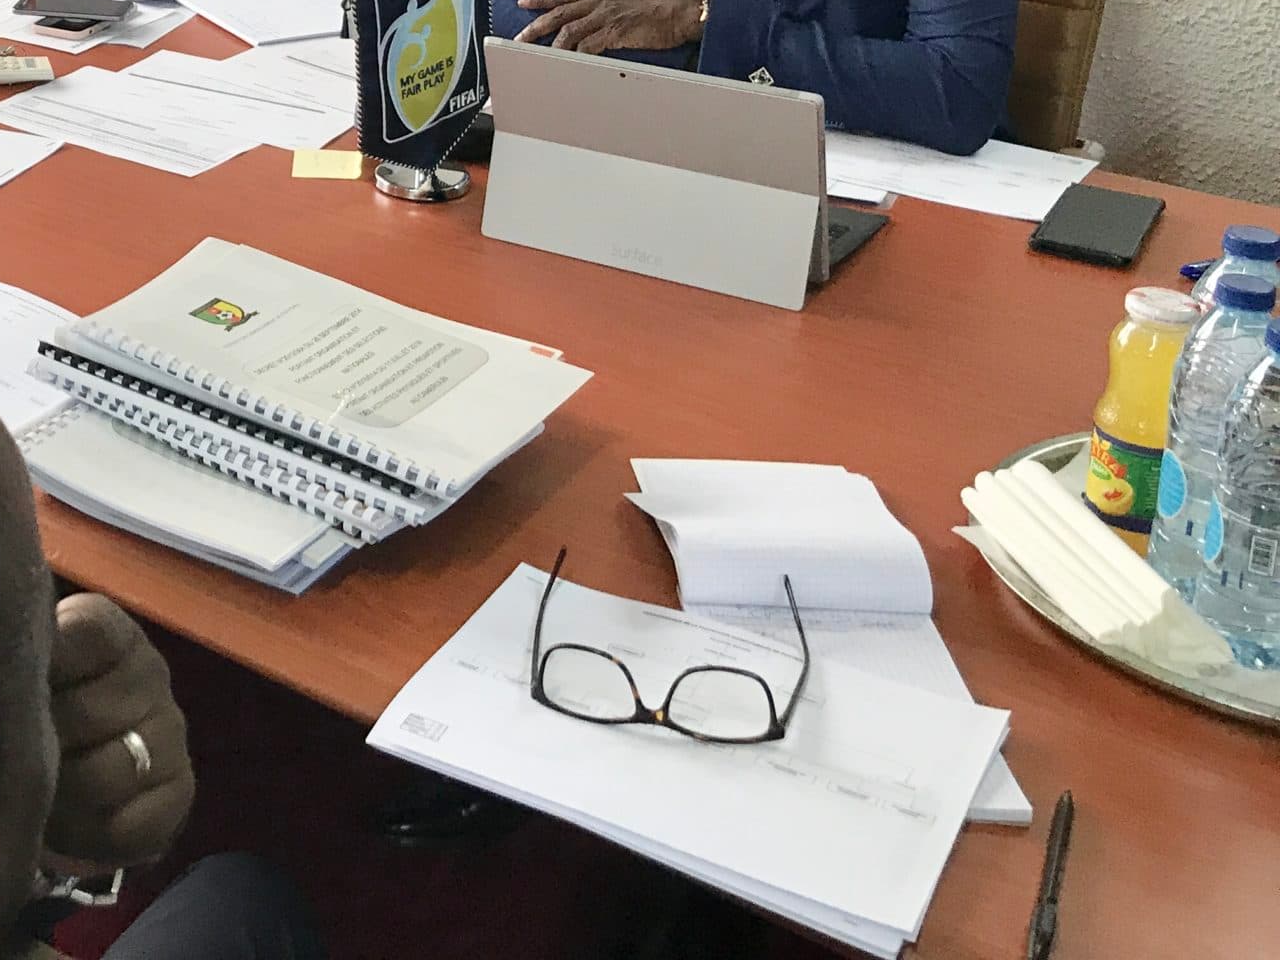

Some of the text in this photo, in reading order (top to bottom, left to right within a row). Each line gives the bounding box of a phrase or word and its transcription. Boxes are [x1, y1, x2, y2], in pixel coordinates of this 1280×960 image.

[400, 56, 454, 87] MY GAME IS
[401, 72, 445, 100] FAIR PLAY
[449, 89, 476, 112] FIFA
